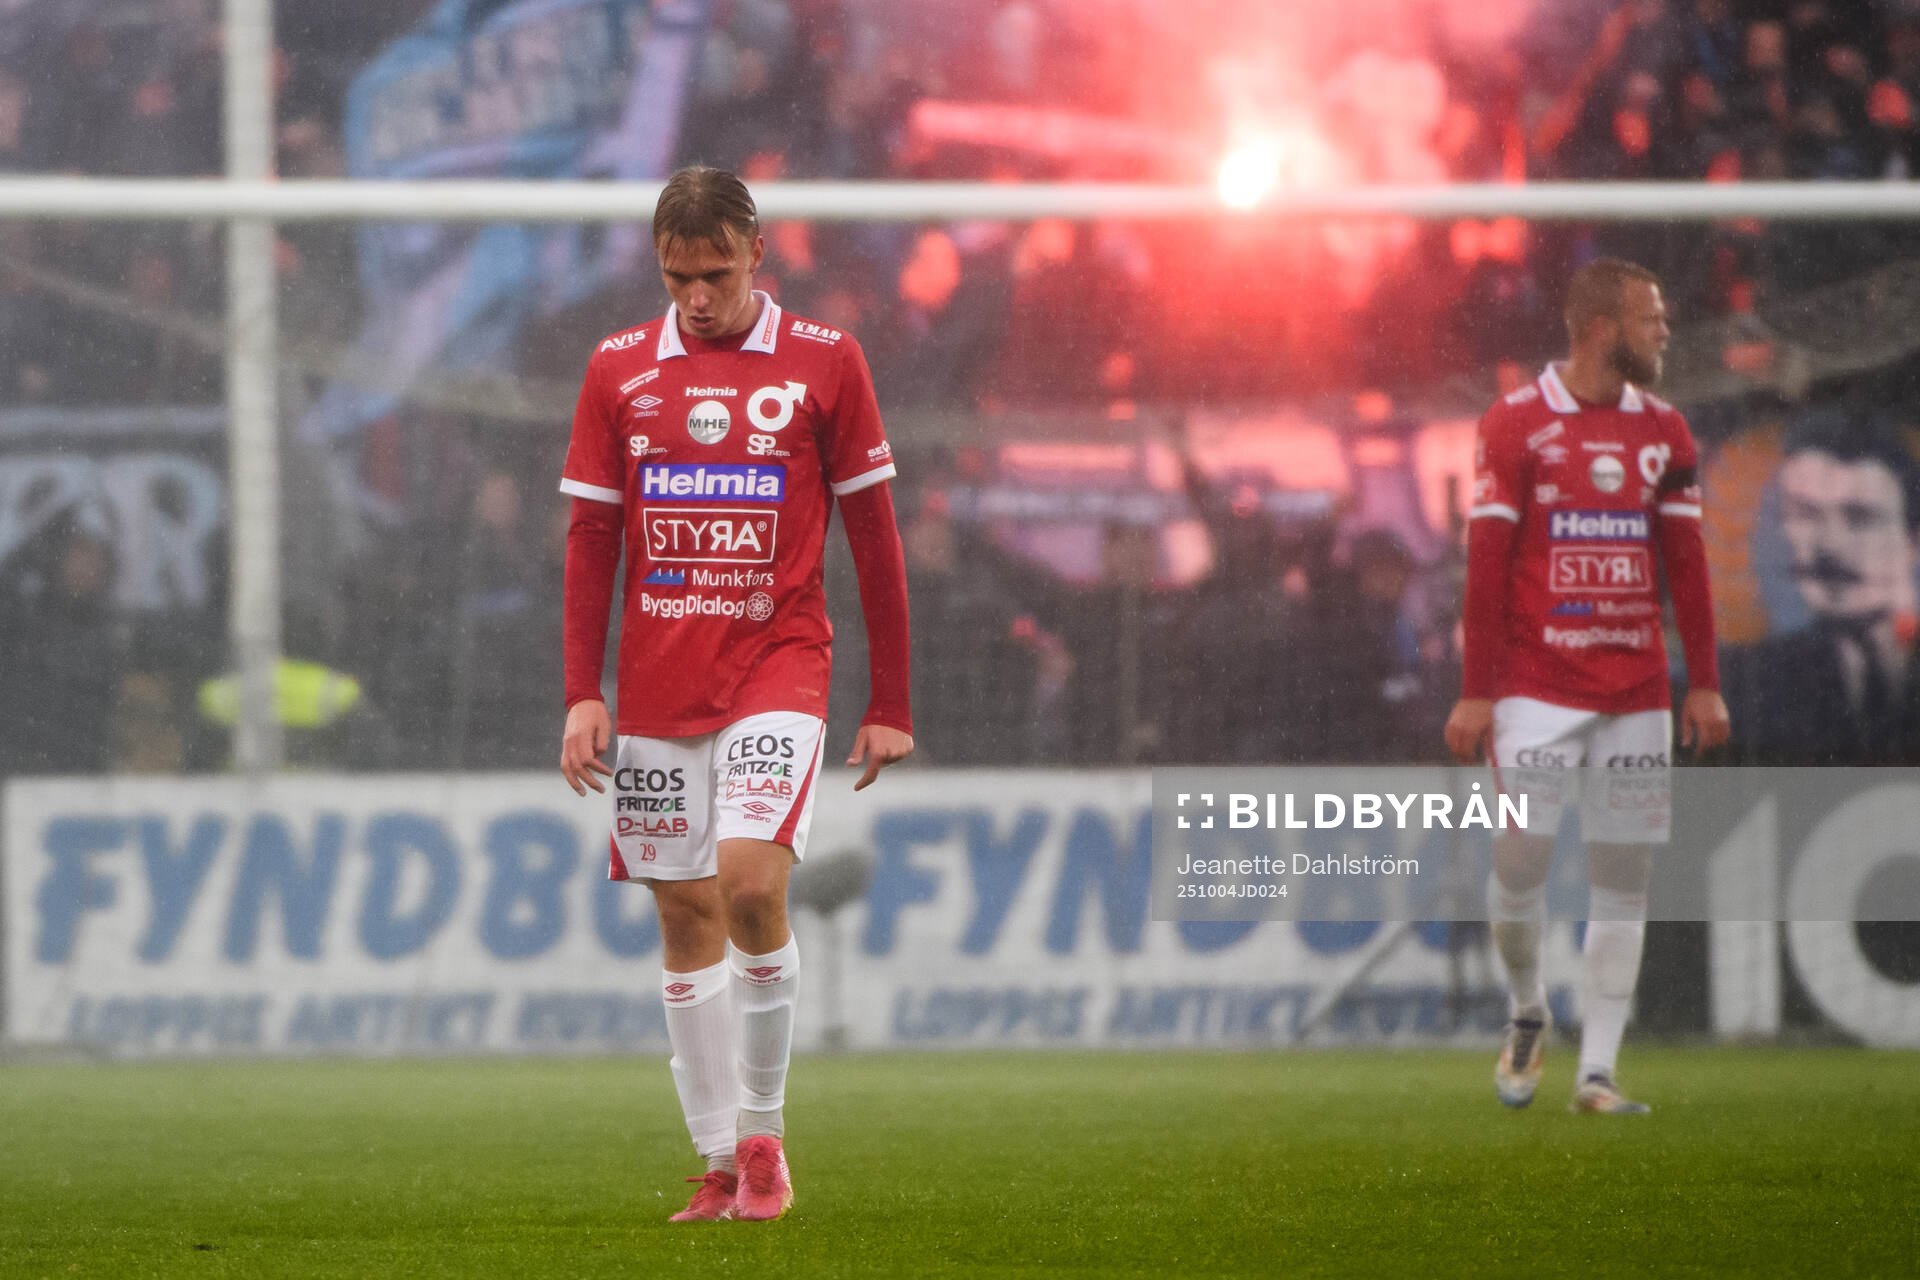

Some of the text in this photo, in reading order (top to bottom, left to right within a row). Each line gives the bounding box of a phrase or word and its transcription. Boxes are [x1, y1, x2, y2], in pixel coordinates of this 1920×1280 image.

[601, 329, 647, 352] AVIS
[791, 321, 842, 341] KMAB
[685, 387, 738, 397] Helmia
[689, 418, 729, 430] MHE
[644, 467, 780, 497] Helmia
[692, 568, 774, 588] Munkfors
[641, 592, 746, 619] ByggDialog
[727, 735, 795, 762] CEOS
[615, 768, 685, 792] CEOS
[726, 777, 793, 801] D-LAB
[617, 816, 688, 833] D-LAB
[743, 813, 772, 823] umbro
[640, 843, 656, 861] 29
